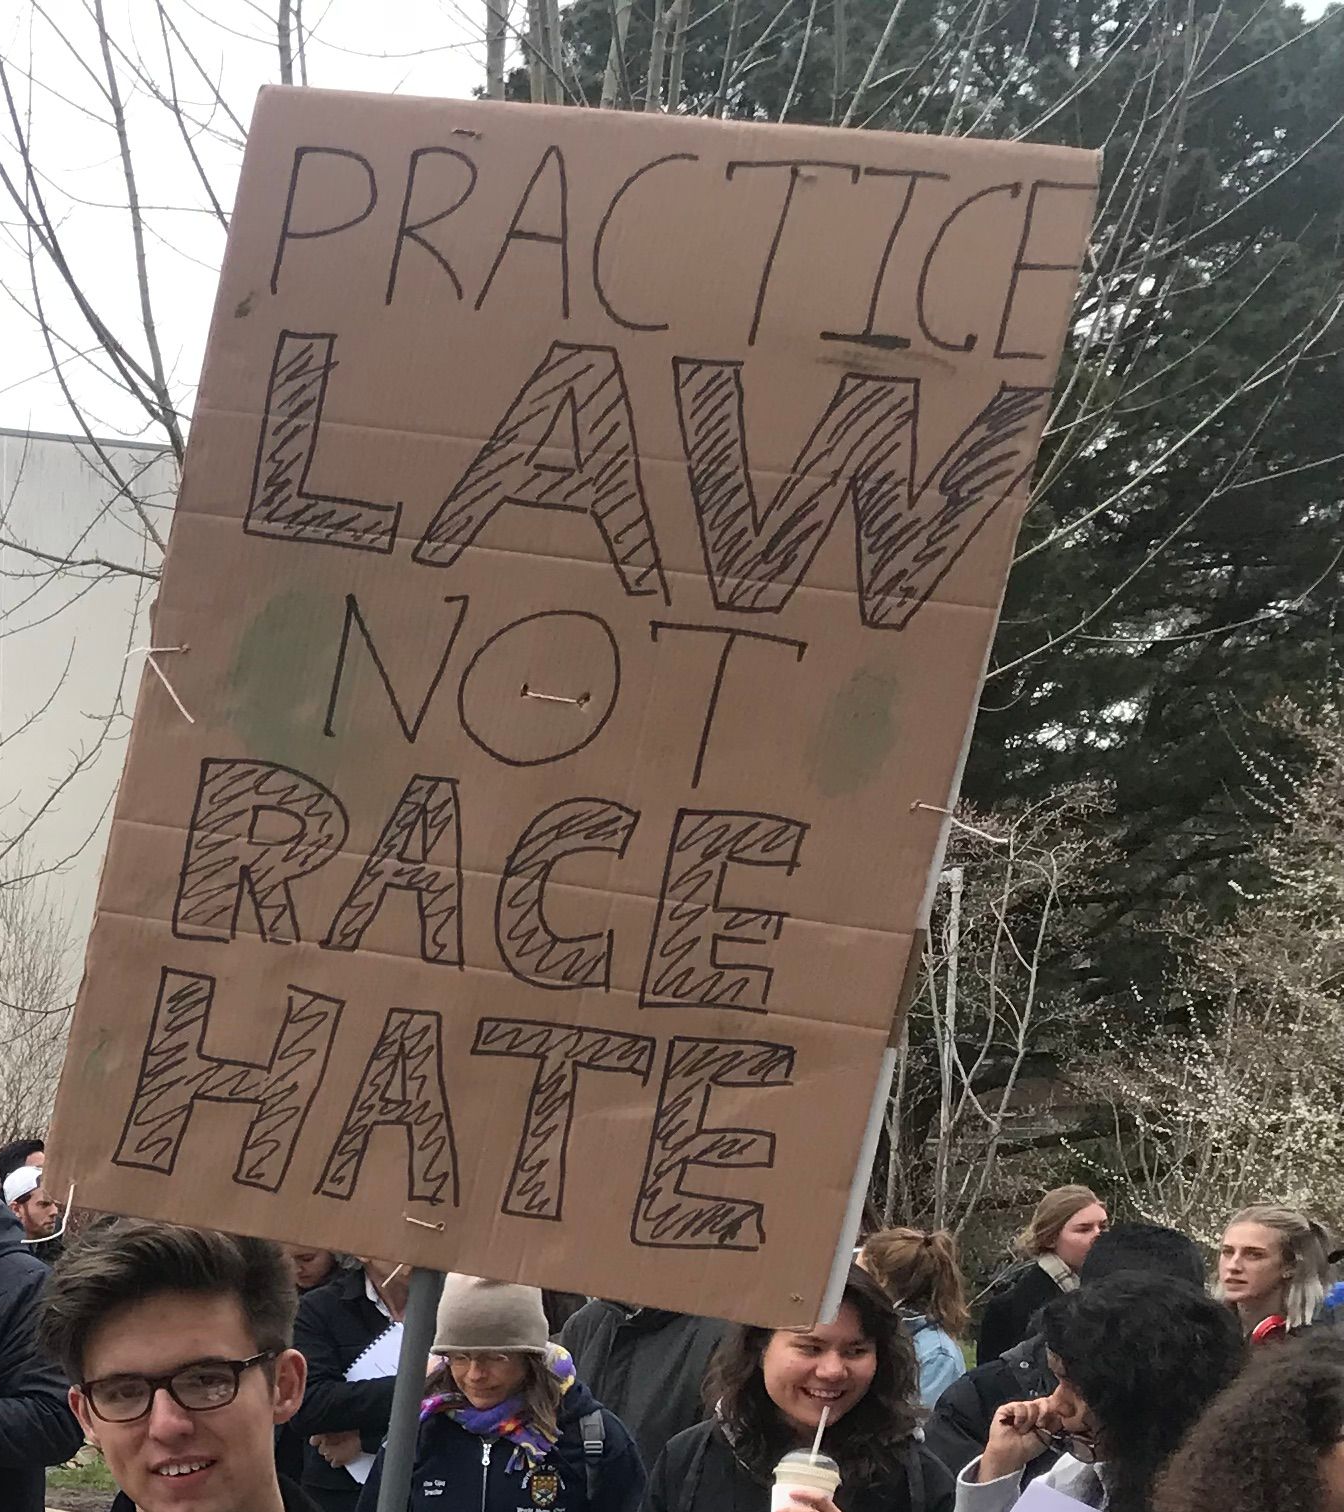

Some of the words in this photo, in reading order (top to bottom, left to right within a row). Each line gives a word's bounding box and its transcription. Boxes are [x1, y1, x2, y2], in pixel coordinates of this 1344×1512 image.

[271, 145, 1096, 359] PRACTICE
[244, 330, 1054, 629] LAW
[324, 594, 808, 787] NOT
[172, 757, 810, 1013] RACE
[112, 967, 795, 1250] HATE
